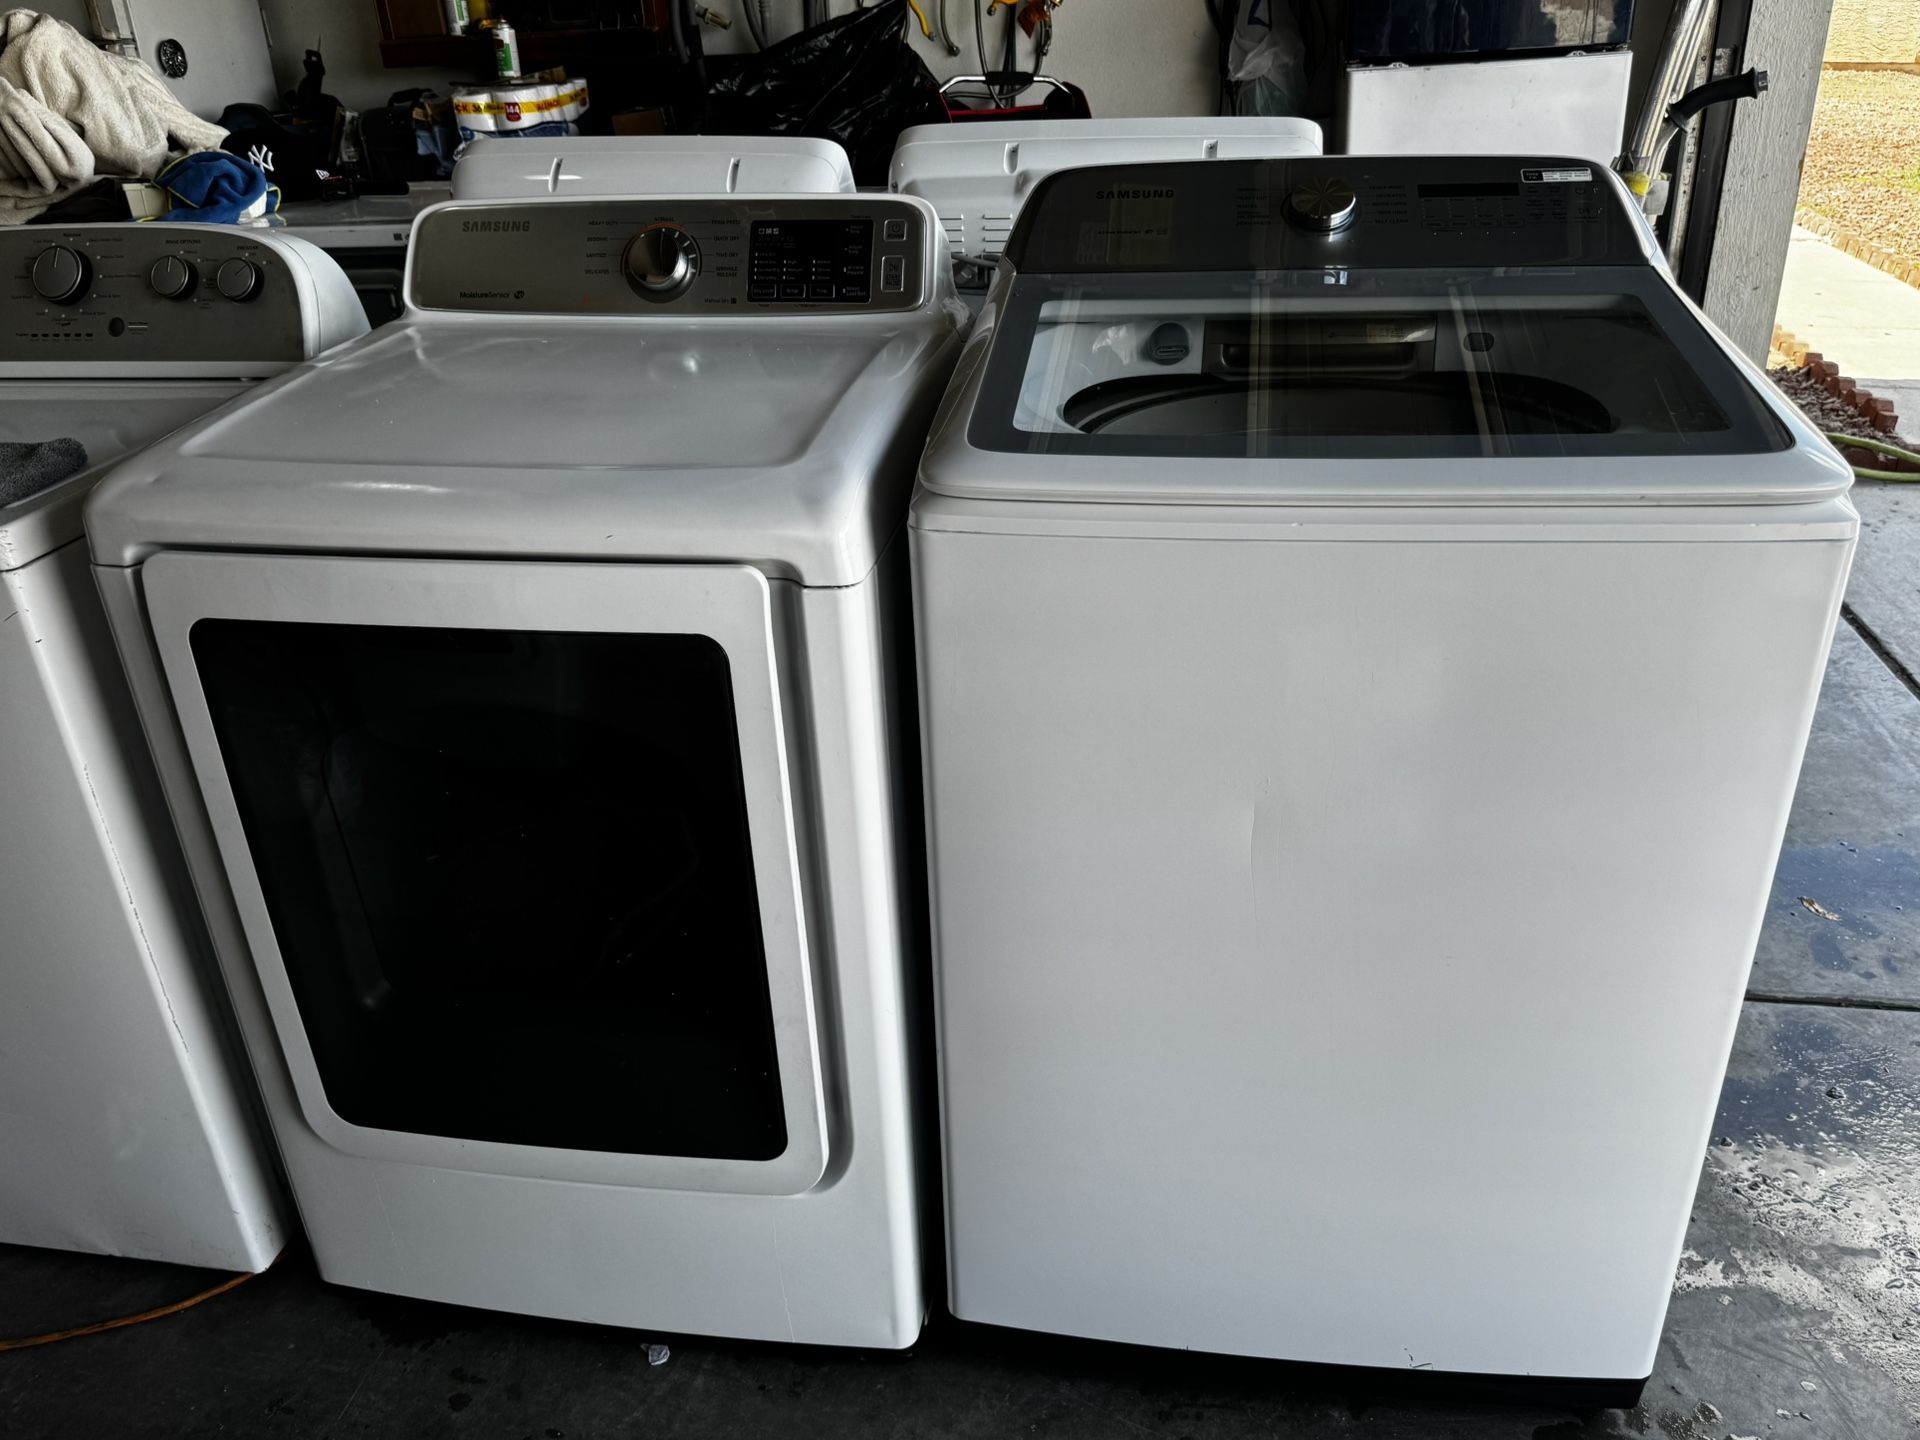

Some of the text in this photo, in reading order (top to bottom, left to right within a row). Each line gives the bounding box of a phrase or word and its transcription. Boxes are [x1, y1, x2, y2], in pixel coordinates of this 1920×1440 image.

[247, 144, 275, 174] NY
[1095, 189, 1175, 200] SAMSUNG
[461, 220, 531, 233] SAMSUNG
[459, 291, 511, 299] MoistureSensor
